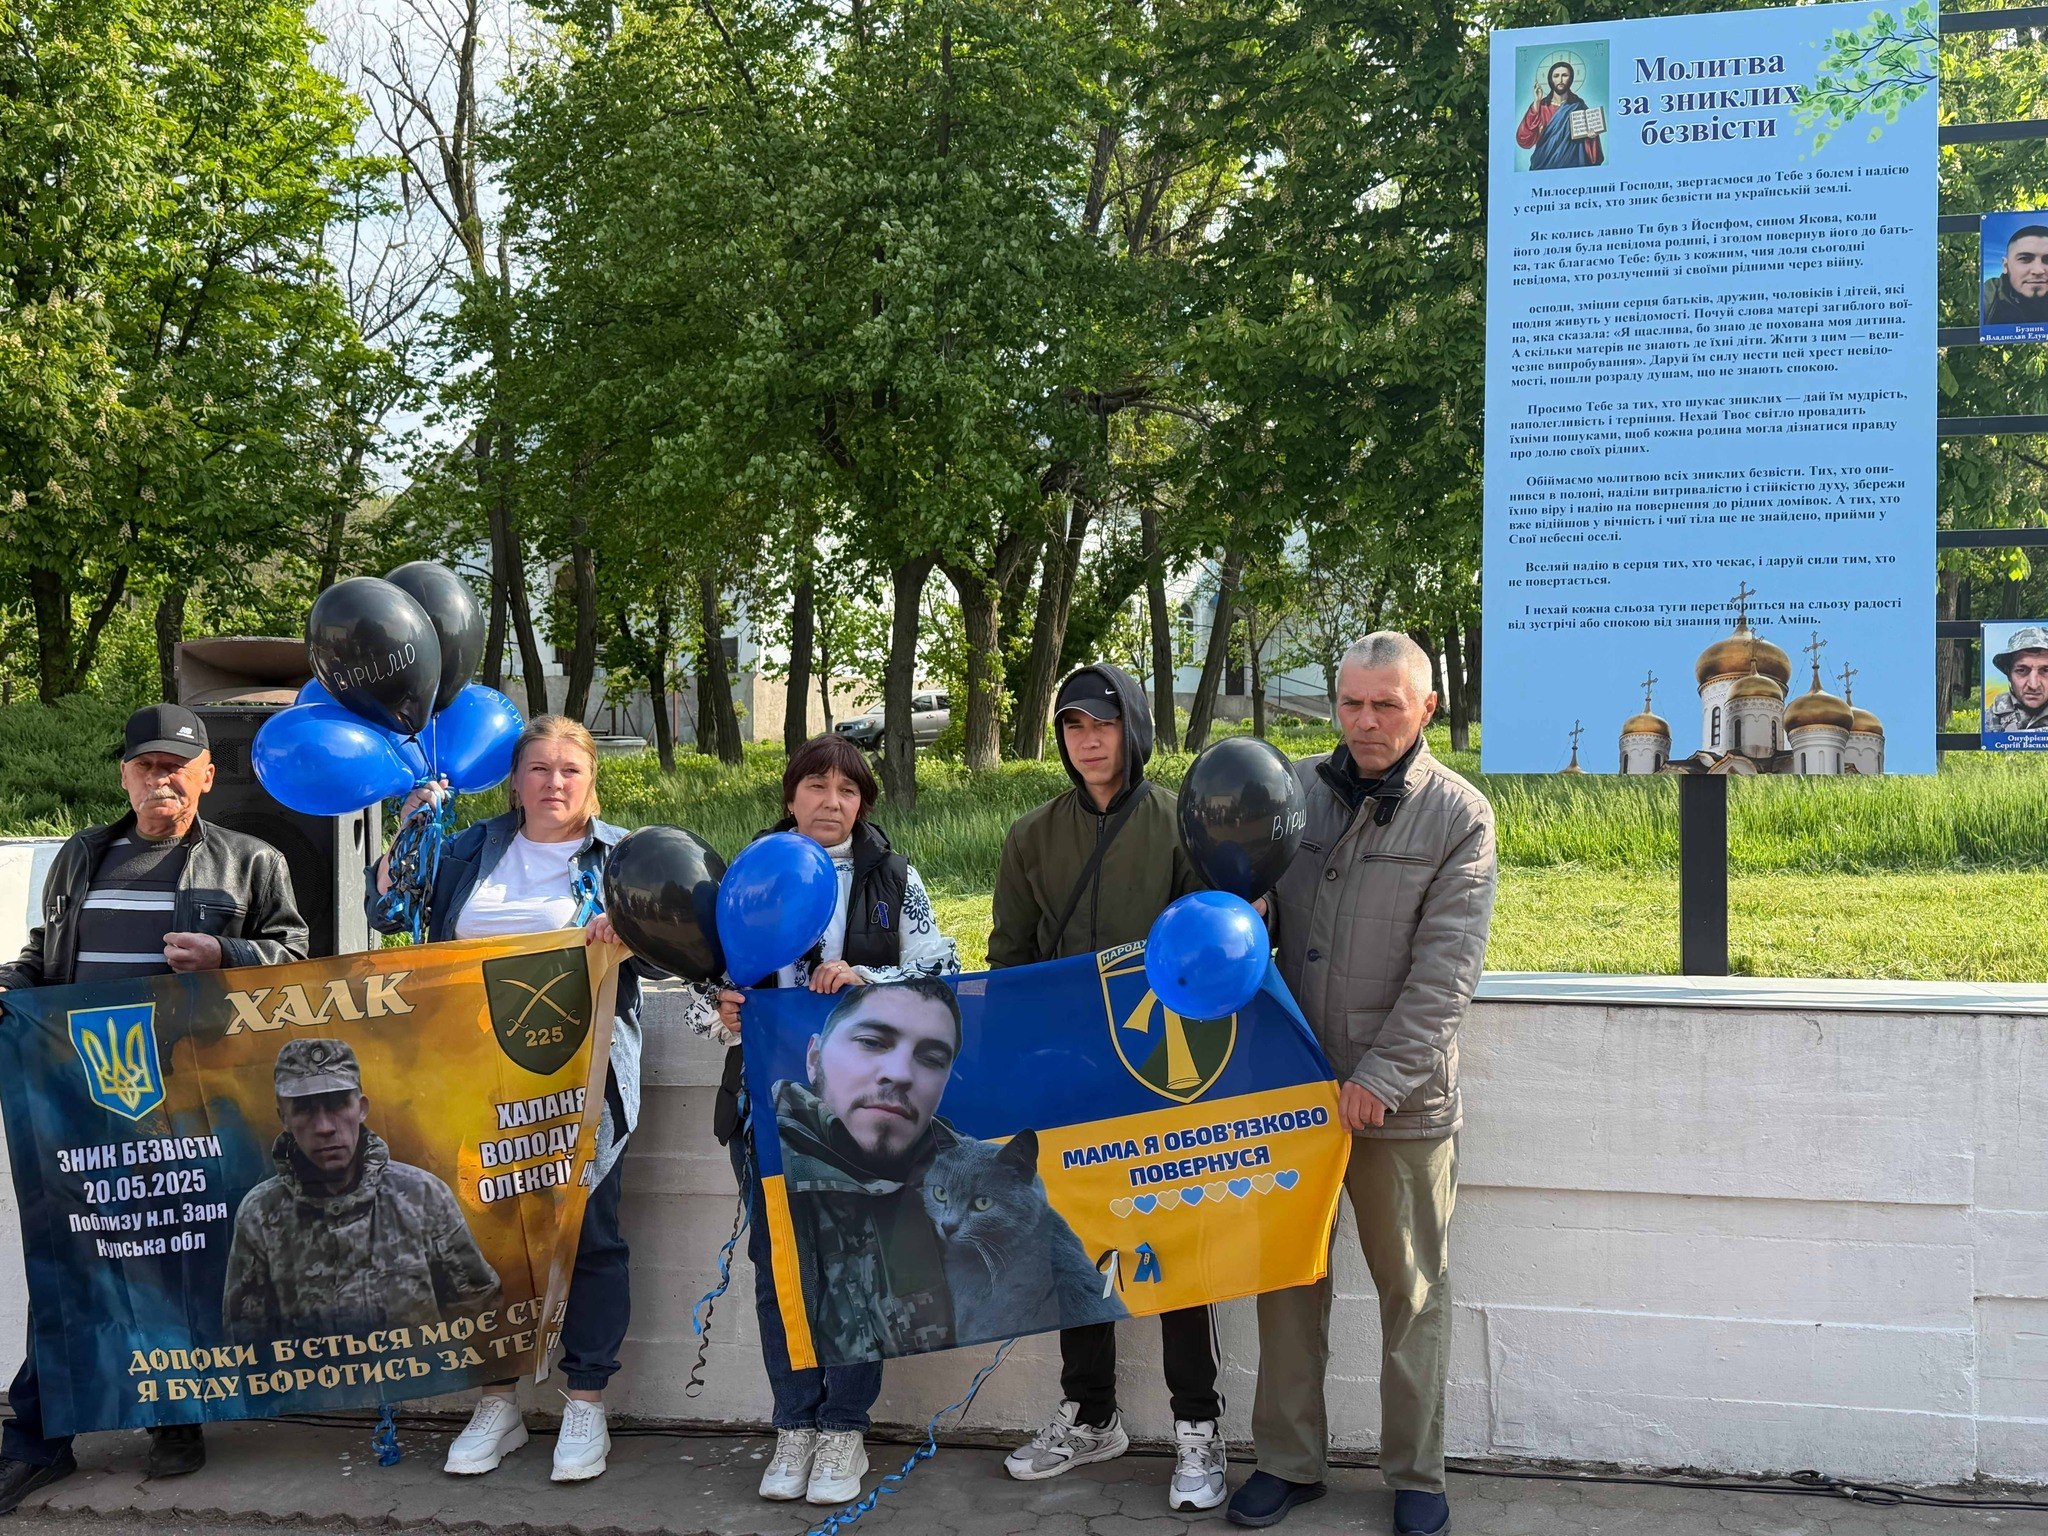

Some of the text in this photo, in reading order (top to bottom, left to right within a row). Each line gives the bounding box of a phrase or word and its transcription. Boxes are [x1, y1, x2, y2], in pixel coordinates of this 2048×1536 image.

[1635, 55, 1785, 83] Молитва
[1619, 86, 1801, 115] за зниклих
[1641, 116, 1776, 144] безвісти
[1531, 182, 1615, 200] Милосердний
[1620, 178, 1672, 193] Господи,
[1676, 175, 1752, 190] звертаємося
[1756, 174, 1771, 183] до
[1774, 169, 1803, 181] Тебе
[1815, 166, 1853, 179] болем
[1865, 163, 1909, 177] надією
[1513, 255, 1863, 286] невідома, хто розлучений зі своїми рідними через війну.
[1528, 303, 1574, 314] осподи,
[1577, 298, 1619, 311] зміцни
[1623, 298, 1658, 310] серця
[1662, 293, 1713, 306] батьків,
[1716, 292, 1768, 305] дружин,
[1772, 287, 1833, 299] чоловіків
[1843, 284, 1881, 298] дітей,
[1884, 283, 1904, 294] які
[1512, 319, 1551, 329] щодня
[1554, 316, 1600, 329] живуть
[1614, 309, 1690, 323] невідомості.
[1694, 306, 1734, 321] Почуй
[1737, 307, 1773, 316] слова
[1777, 302, 1818, 317] матері
[1822, 299, 1885, 312] загиблого
[1889, 298, 1912, 309] вої-
[1511, 343, 1892, 373] чезне випробування». Даруй їм силу нести цей хрест невідо-
[1511, 363, 1838, 387] мості, пошли розраду душам, що не знають спокою.
[1509, 420, 1897, 444] їхніми пошуками, щоб кожна родина могла дізнатися правду
[1510, 415, 1604, 429] наполегливість
[1615, 412, 1675, 427] терпіння.
[1679, 410, 1717, 422] Нехай
[1721, 409, 1751, 420] Твоє
[1754, 407, 1794, 418] світло
[1798, 407, 1866, 419] провадить
[1510, 443, 1649, 460] про долю своїх рідних.
[1509, 492, 1545, 501] нився
[1560, 488, 1604, 500] полоні,
[1607, 486, 1648, 498] наділи
[1652, 483, 1742, 498] витривалістю
[1753, 480, 1815, 492] стійкістю
[1818, 482, 1849, 492] духу,
[1852, 477, 1905, 492] збережи
[1526, 474, 1593, 486] Обіймаємо
[1596, 473, 1660, 483] молитвою
[1664, 470, 1688, 481] всіх
[1692, 470, 1745, 479] зниклих
[1749, 466, 1804, 478] безвісти.
[1808, 465, 1836, 477] Тих,
[1865, 466, 1894, 474] опи-
[1508, 531, 1621, 544] Свої небесні оселі.
[1533, 604, 1567, 614] нехай
[1572, 605, 1610, 613] кожна
[1614, 604, 1654, 613] сльоза
[1658, 604, 1686, 614] туги
[1690, 599, 1785, 614] перетвориться
[1789, 601, 1804, 609] на
[1808, 601, 1850, 611] сльозу
[1854, 597, 1901, 611] радості
[1508, 613, 1820, 631] від зустрічі або спокою від знання правди. Амінь.
[1995, 741, 2021, 750] Сергій
[224, 970, 417, 1036] ХАЛК
[525, 1026, 564, 1047] 225
[1062, 1105, 1330, 1170] МАМА Я ОБОВ'ЯЗКОВО
[57, 1135, 223, 1173] ЗНИК БЕЗВІСТИ
[1129, 1145, 1271, 1187] ПОВЕРНУСЯ
[83, 1168, 207, 1204] 20.05.2025
[69, 1202, 228, 1233] Поблизу н.п. Заря
[96, 1231, 206, 1259] Курська обл
[128, 1343, 259, 1376] ДОПОКИ
[270, 1327, 414, 1363] Б'ЄТЬСЯ
[418, 1309, 499, 1346] МОЄ
[137, 1379, 159, 1403] Я
[166, 1375, 240, 1404] БУДУ
[246, 1356, 431, 1397] БОРОТИСЬ
[437, 1346, 486, 1371] ЗА
[488, 1328, 539, 1359] ТЕ
